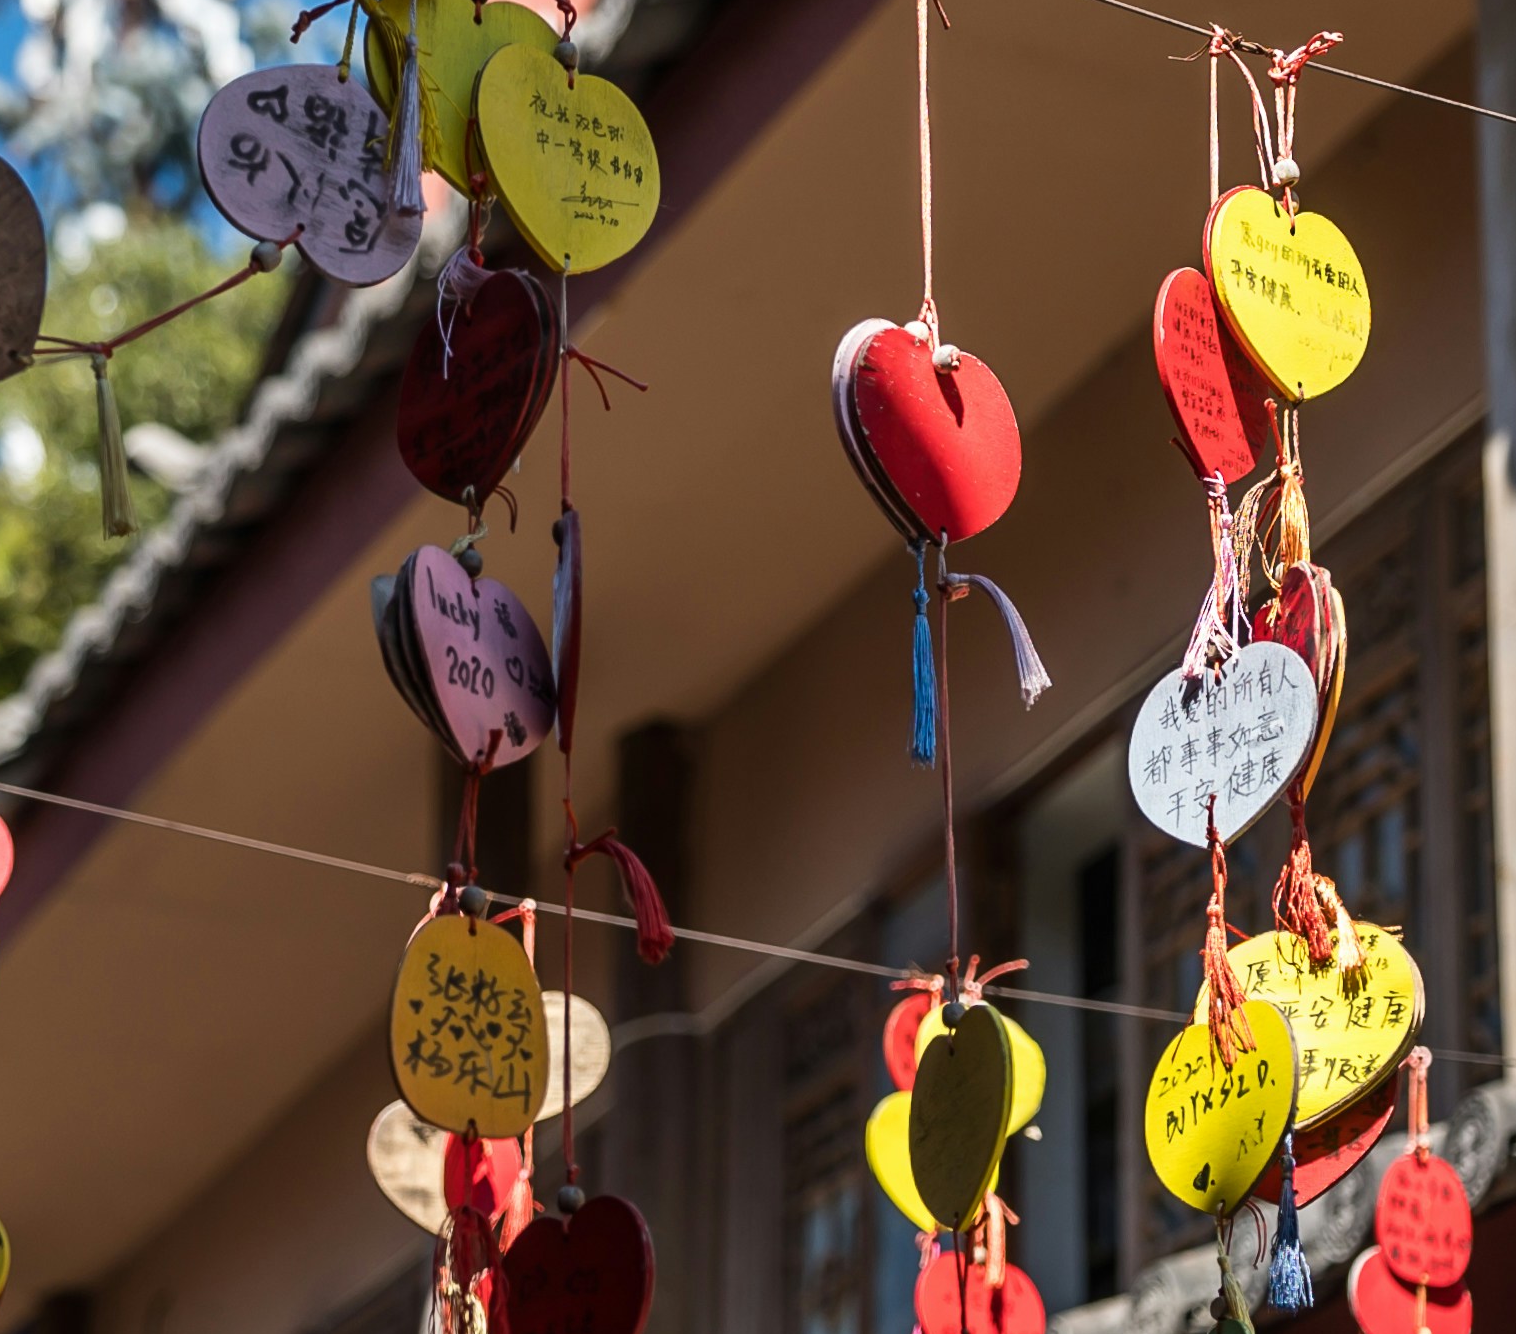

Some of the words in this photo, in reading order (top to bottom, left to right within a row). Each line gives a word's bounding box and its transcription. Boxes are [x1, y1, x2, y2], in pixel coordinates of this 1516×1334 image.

[425, 565, 481, 642] lucky
[445, 645, 496, 700] 2020
[1158, 658, 1299, 732] 我爱的所有人
[1142, 706, 1285, 788] 都事事如意
[1166, 747, 1284, 829] 平安健康
[1280, 990, 1408, 1029] 平安健康
[1300, 1048, 1381, 1091] 事顺遂
